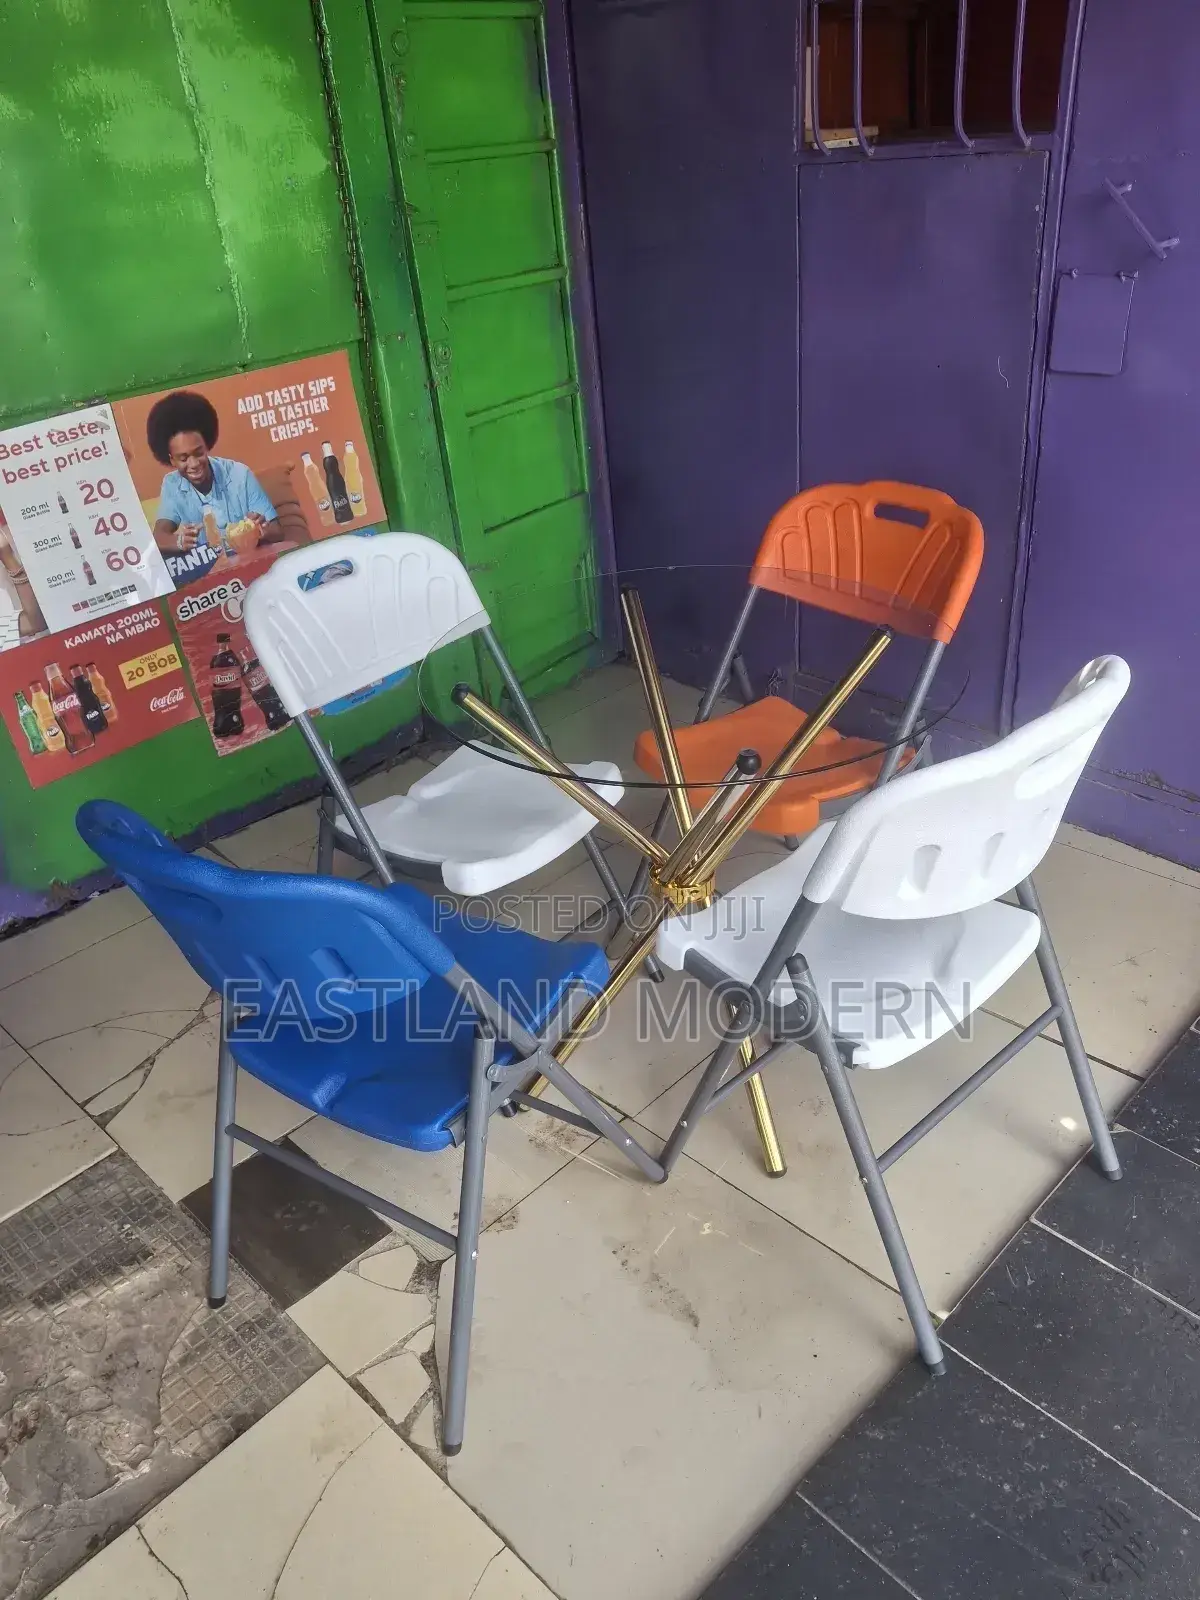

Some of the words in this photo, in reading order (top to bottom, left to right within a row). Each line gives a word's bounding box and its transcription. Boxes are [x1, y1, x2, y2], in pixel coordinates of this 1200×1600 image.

[237, 394, 264, 415] ADD
[265, 383, 305, 407] TASTY
[308, 376, 336, 395] SIPS
[250, 409, 277, 430] FOR
[278, 396, 330, 422] TASTIER
[269, 418, 319, 443] CRISPS.
[2, 458, 50, 485] best
[54, 440, 109, 473] price!
[79, 478, 115, 506] 20
[20, 505, 37, 516] 200
[38, 501, 50, 511] ml
[94, 512, 128, 536] 40
[33, 538, 49, 549] 300
[50, 534, 62, 543] ml
[105, 546, 141, 572] 60
[46, 573, 63, 584] 500
[64, 569, 75, 579] ml
[179, 586, 228, 619] share
[230, 580, 243, 594] a
[64, 622, 116, 649] KAMATA
[116, 607, 158, 629] 200ML
[105, 633, 124, 645] NA
[125, 617, 161, 638] MBAO
[126, 668, 145, 682] 20
[147, 653, 178, 673] BOB
[139, 653, 158, 665] ONLY
